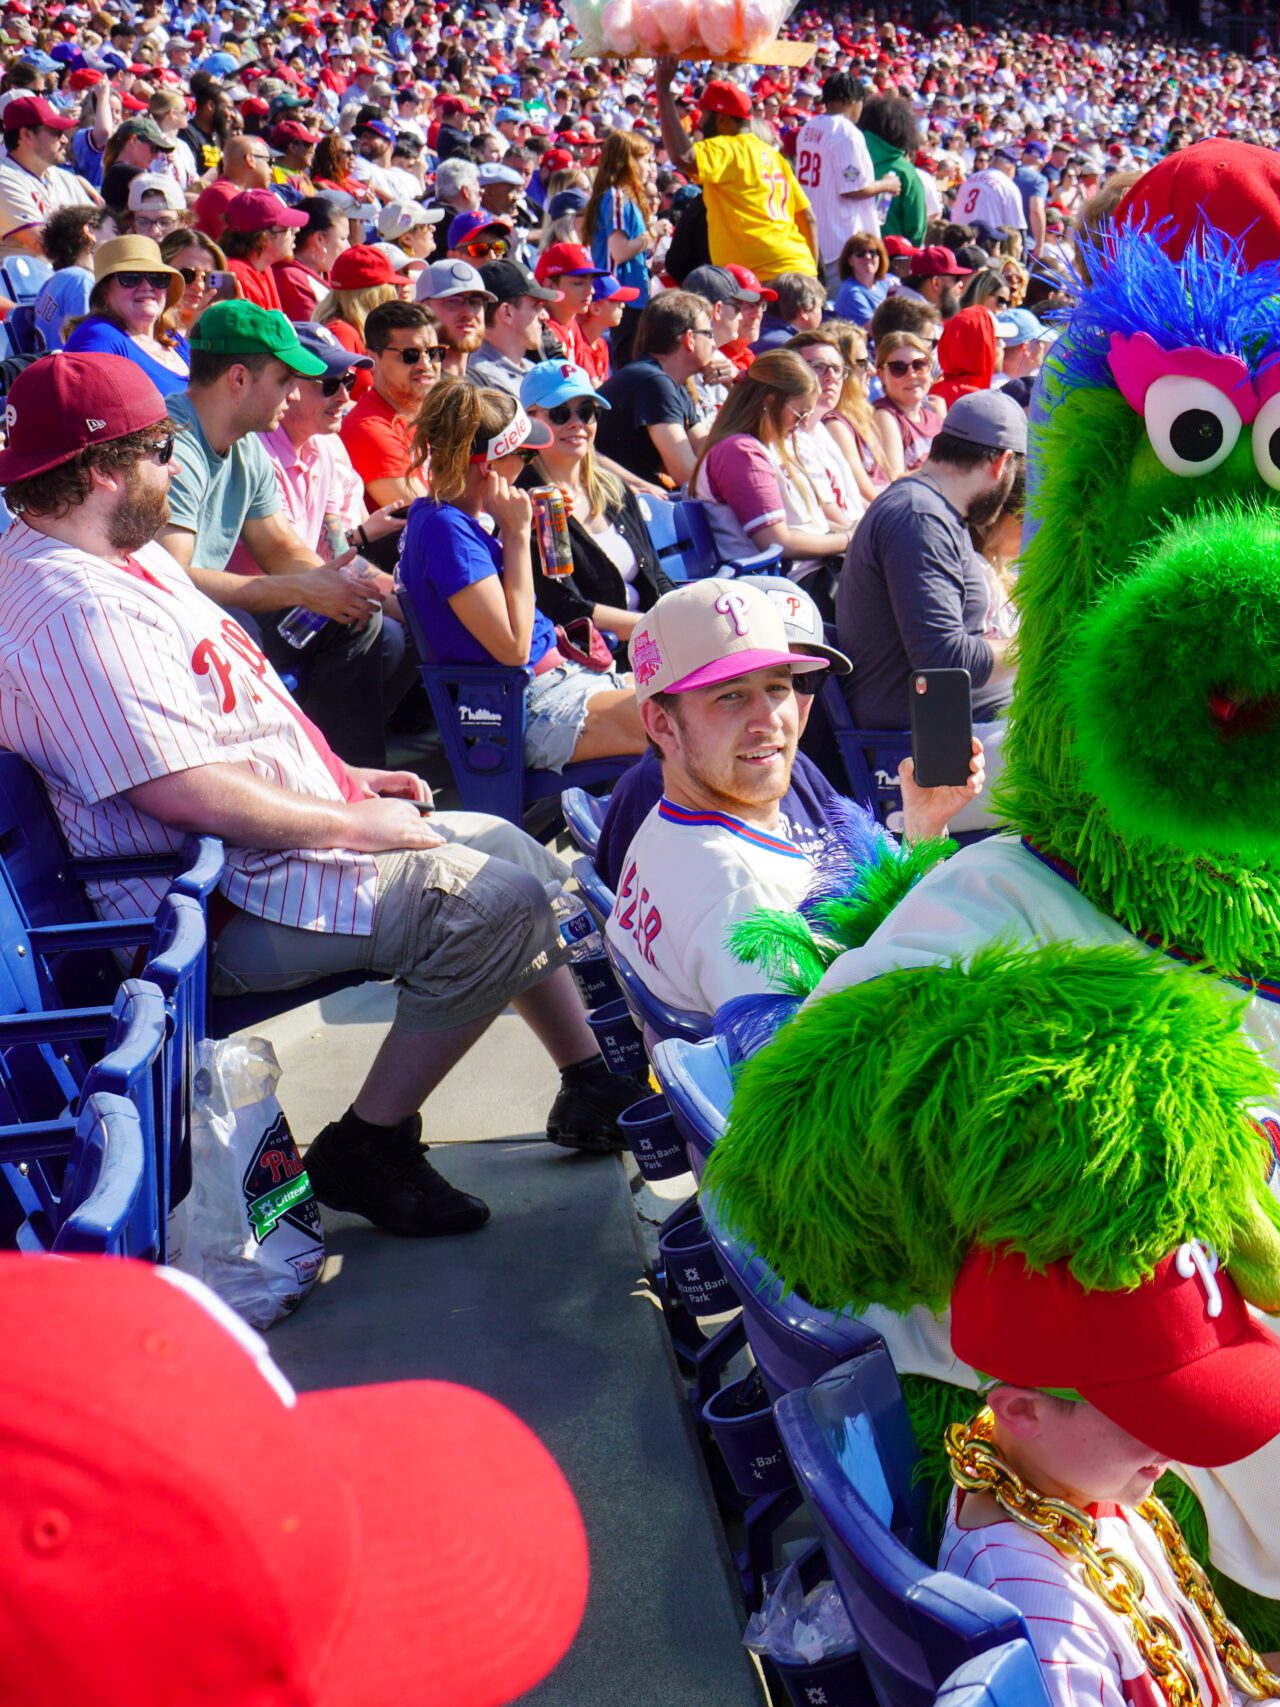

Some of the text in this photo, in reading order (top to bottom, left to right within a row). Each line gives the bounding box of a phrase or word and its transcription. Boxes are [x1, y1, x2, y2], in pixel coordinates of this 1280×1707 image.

[798, 150, 821, 188] 28
[964, 187, 980, 214] 3
[493, 416, 528, 456] ciele
[714, 591, 751, 637] P
[786, 596, 801, 618] P
[643, 1160, 664, 1170] Park
[656, 1144, 681, 1159] Bank
[1175, 1237, 1223, 1318] P
[689, 1291, 711, 1303] Park
